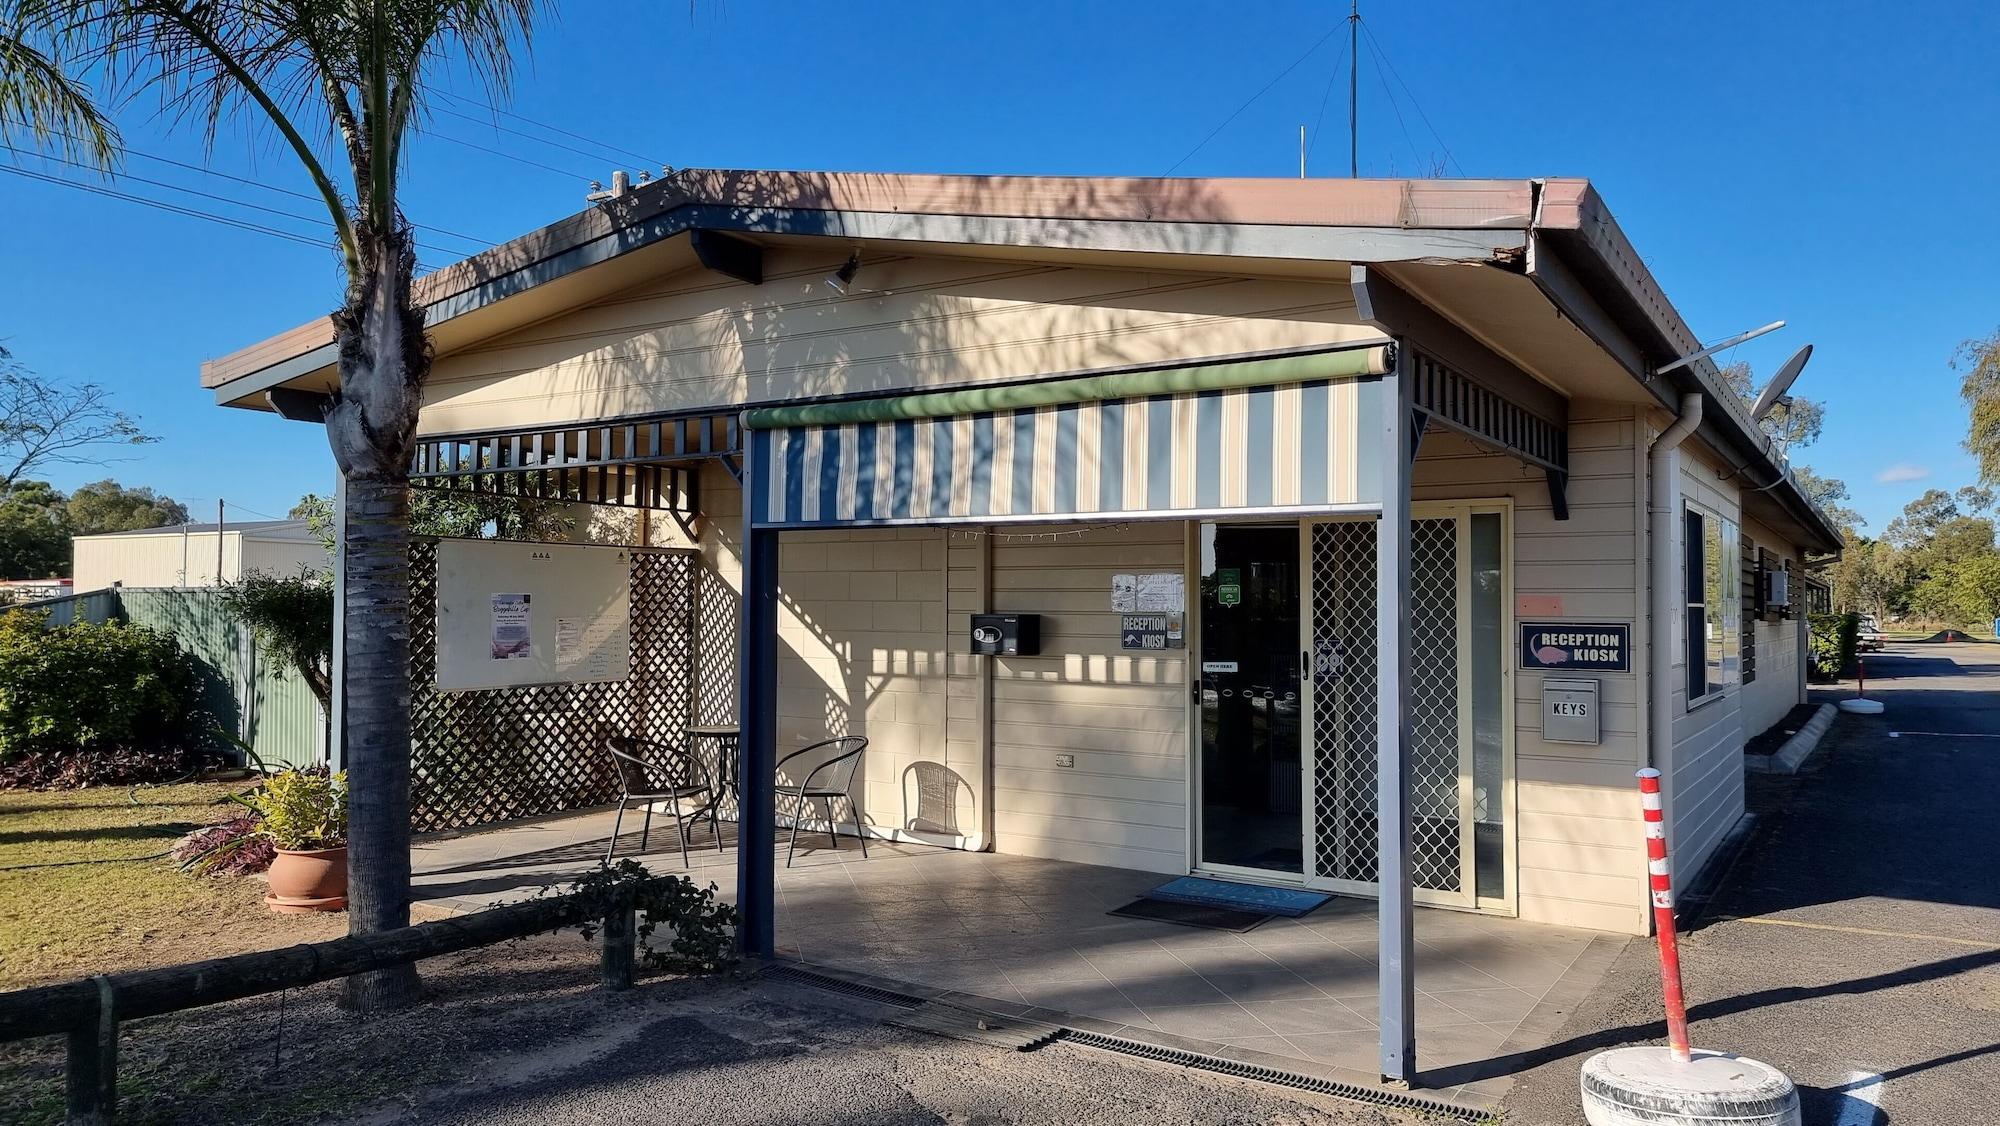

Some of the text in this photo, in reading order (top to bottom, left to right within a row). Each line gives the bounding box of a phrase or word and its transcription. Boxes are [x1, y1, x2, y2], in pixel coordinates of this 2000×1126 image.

[1123, 617, 1166, 631] RECEPTION
[1142, 634, 1166, 648] KIOSK
[1541, 633, 1619, 647] RECEPTION
[1573, 648, 1619, 662] KIOSK
[1553, 702, 1586, 716] KEYS
